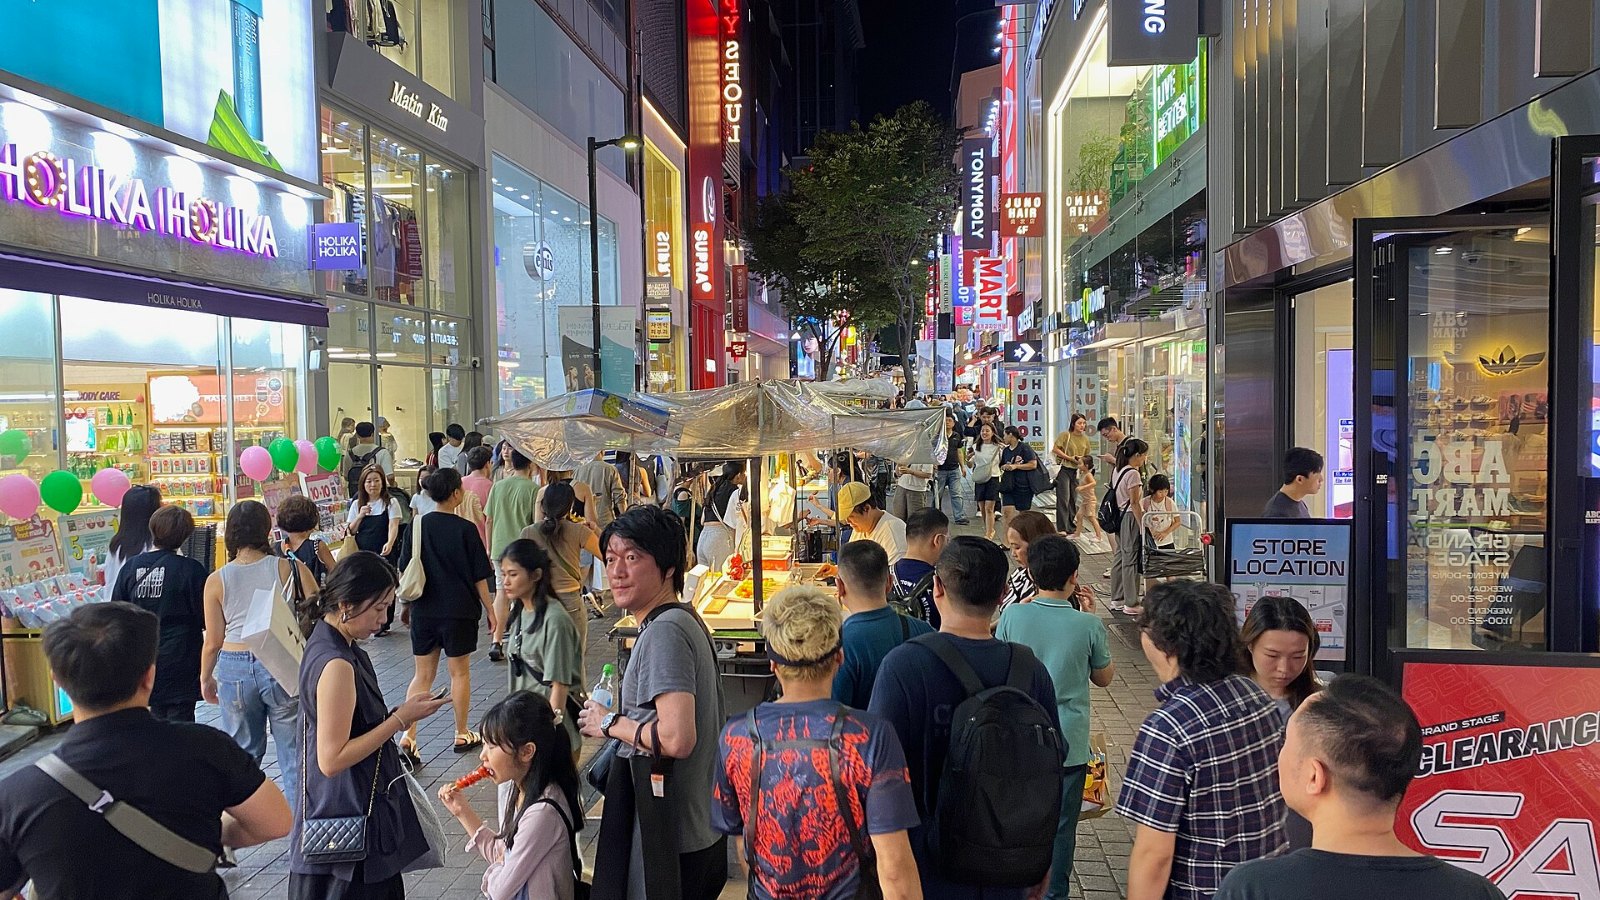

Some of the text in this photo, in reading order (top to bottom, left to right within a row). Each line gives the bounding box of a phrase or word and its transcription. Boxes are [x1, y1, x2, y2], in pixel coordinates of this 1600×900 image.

[390, 81, 449, 132] Matin Kim
[0, 143, 279, 258] HOLIKA HOLIKA
[970, 148, 984, 240] TONYMOLY
[1005, 197, 1041, 208] JUNO
[1008, 208, 1037, 218] HAIR
[1016, 225, 1029, 235] 4F
[318, 236, 357, 247] HOLIKA
[318, 246, 357, 257] HOLIKA
[694, 229, 709, 285] SUPRA
[979, 259, 1003, 321] MART
[147, 292, 203, 310] HOLIKA HOLIKA
[1432, 311, 1468, 327] ABC
[1432, 327, 1468, 338] MART
[99, 390, 120, 401] CARE
[1017, 378, 1042, 438] JUNO HAIR
[1252, 539, 1327, 556] STORE
[1233, 559, 1345, 576] LOCATION
[1461, 713, 1500, 729] STAGE
[1413, 711, 1600, 779] CLEARANC
